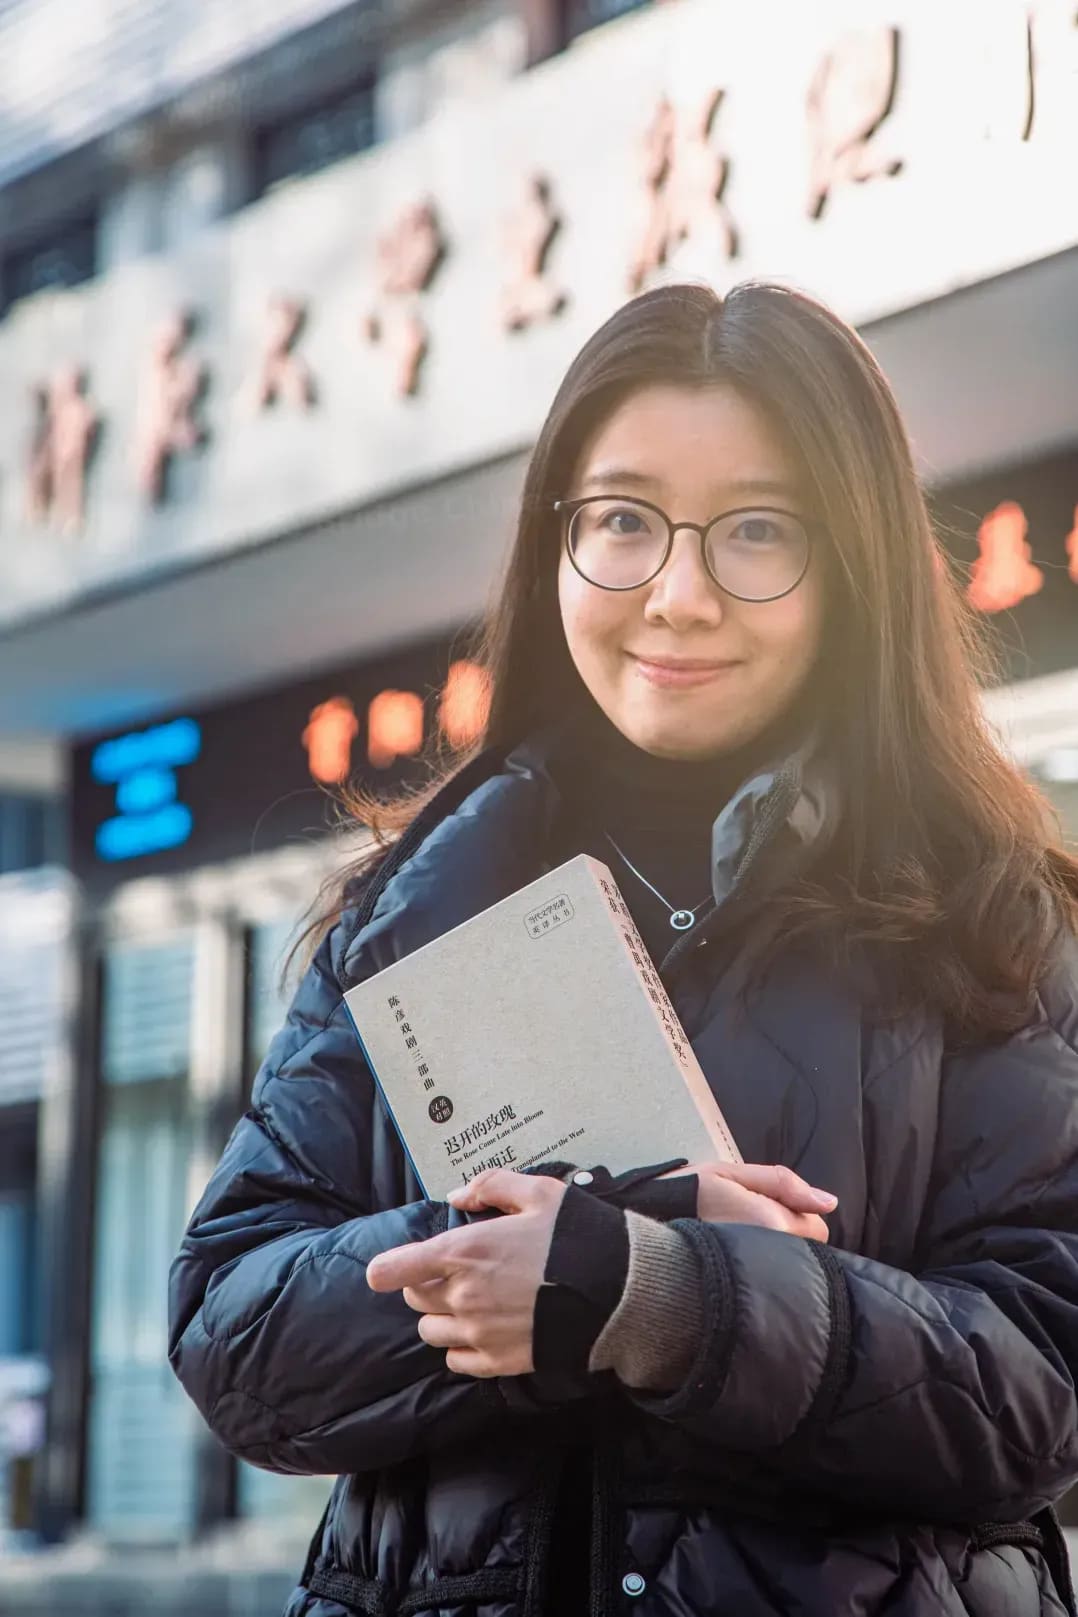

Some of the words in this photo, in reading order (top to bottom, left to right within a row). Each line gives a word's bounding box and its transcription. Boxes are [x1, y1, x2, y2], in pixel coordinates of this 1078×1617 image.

[387, 994, 436, 1092] 陈彦戏剧三部曲
[444, 1104, 517, 1157] 迟开的玫瑰
[450, 1156, 463, 1167] The
[463, 1149, 478, 1160] Rose
[478, 1138, 496, 1150] Come
[497, 1129, 511, 1140] Late
[511, 1121, 524, 1132] into
[523, 1109, 544, 1126] Bloom
[511, 1146, 551, 1173] Transplanted
[551, 1143, 559, 1151] to
[559, 1137, 569, 1147] the
[569, 1127, 585, 1140] West
